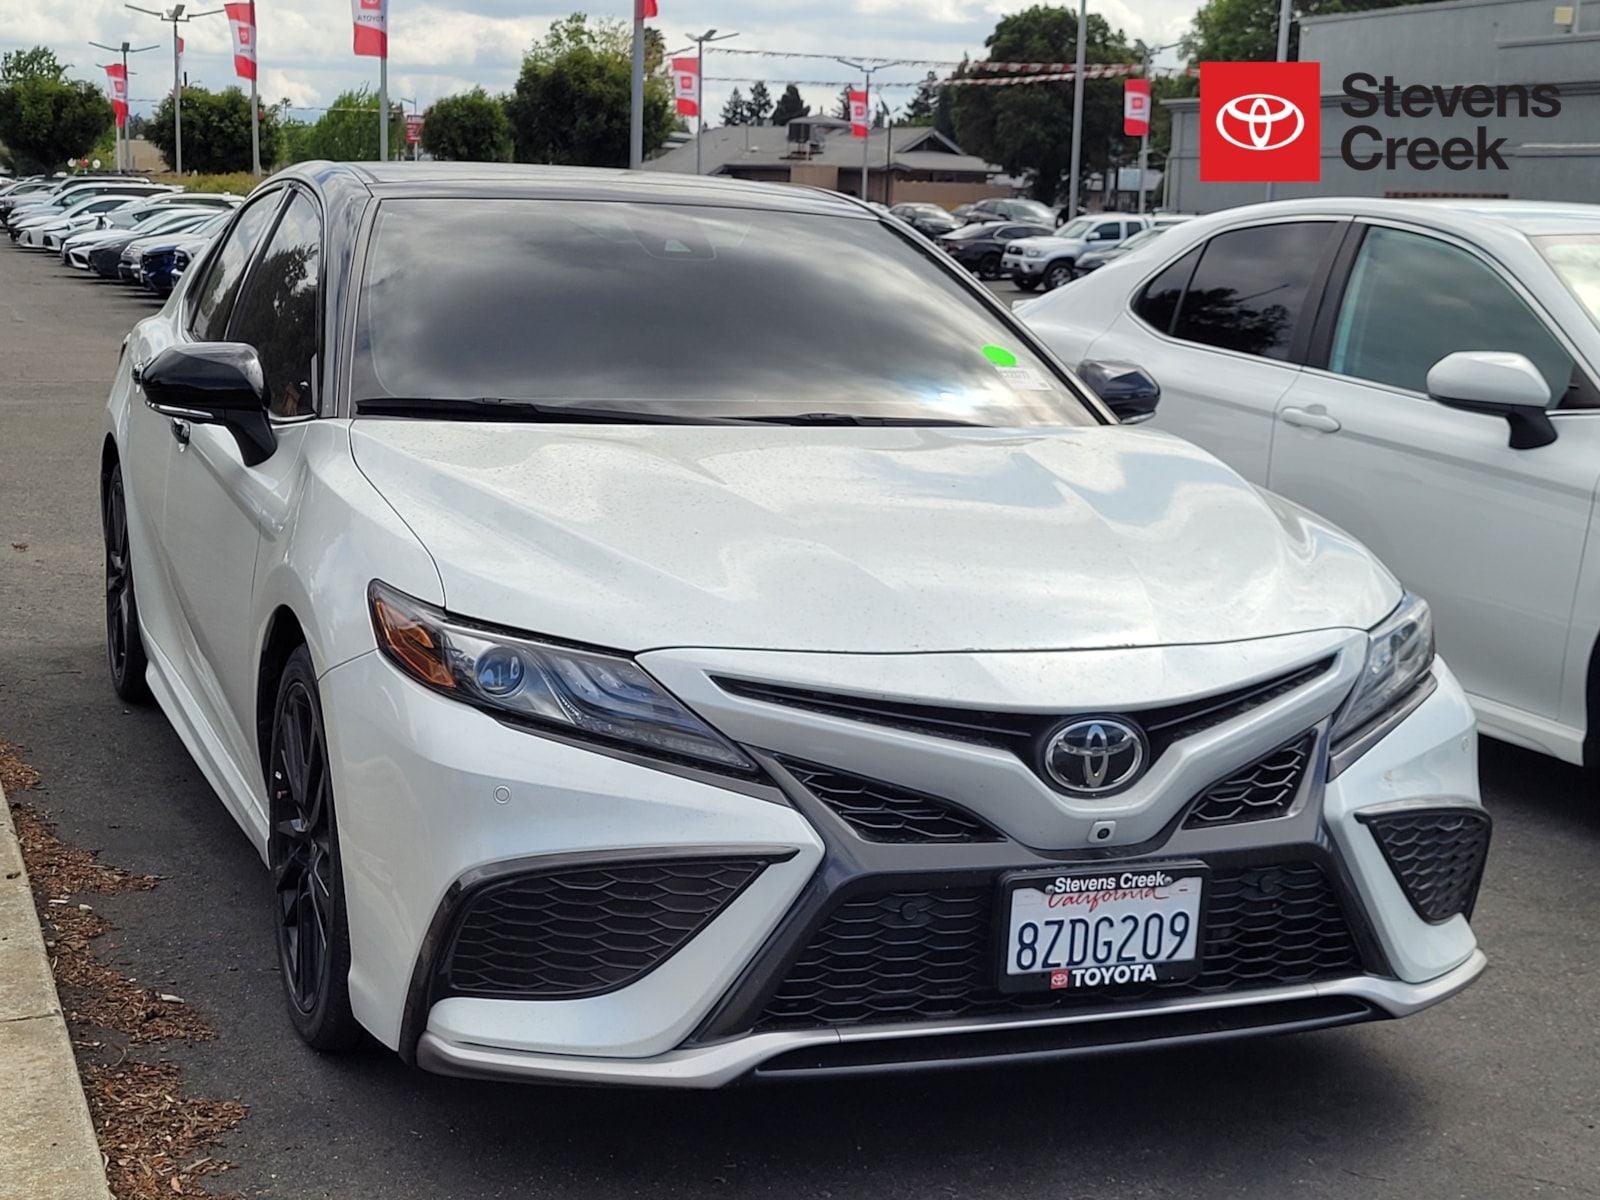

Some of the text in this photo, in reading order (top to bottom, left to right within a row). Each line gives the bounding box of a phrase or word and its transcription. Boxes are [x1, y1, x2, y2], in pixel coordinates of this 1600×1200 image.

[1054, 871, 1165, 892] Stevens Creek
[1016, 911, 1190, 970] 8ZDG209
[1072, 964, 1157, 987] TOYOTA
